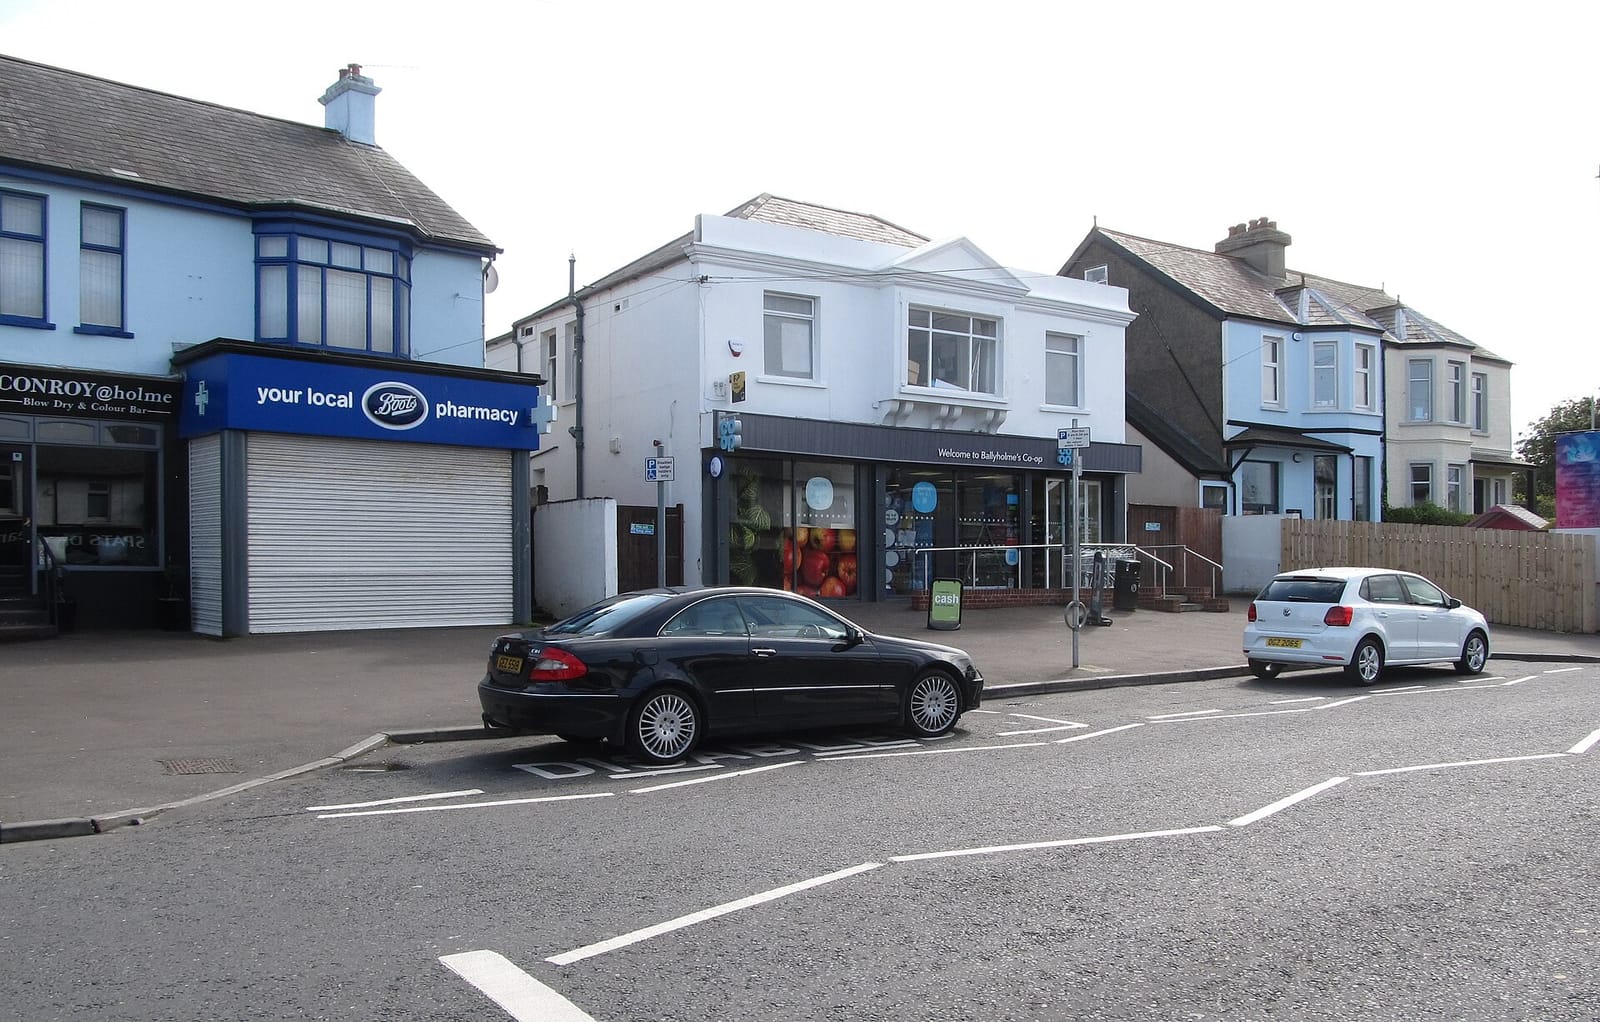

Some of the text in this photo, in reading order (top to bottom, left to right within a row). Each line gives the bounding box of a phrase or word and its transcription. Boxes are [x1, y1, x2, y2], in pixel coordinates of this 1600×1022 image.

[0, 375, 173, 403] CONROY@holme
[257, 387, 353, 408] your local
[23, 397, 148, 415] Blow Dry & Colour Bar
[374, 392, 418, 417] Boots
[436, 401, 518, 426] pharmacy
[649, 460, 655, 469] P
[938, 448, 1043, 465] Welcome to Ballyholme's Co-op
[934, 593, 959, 604] cash
